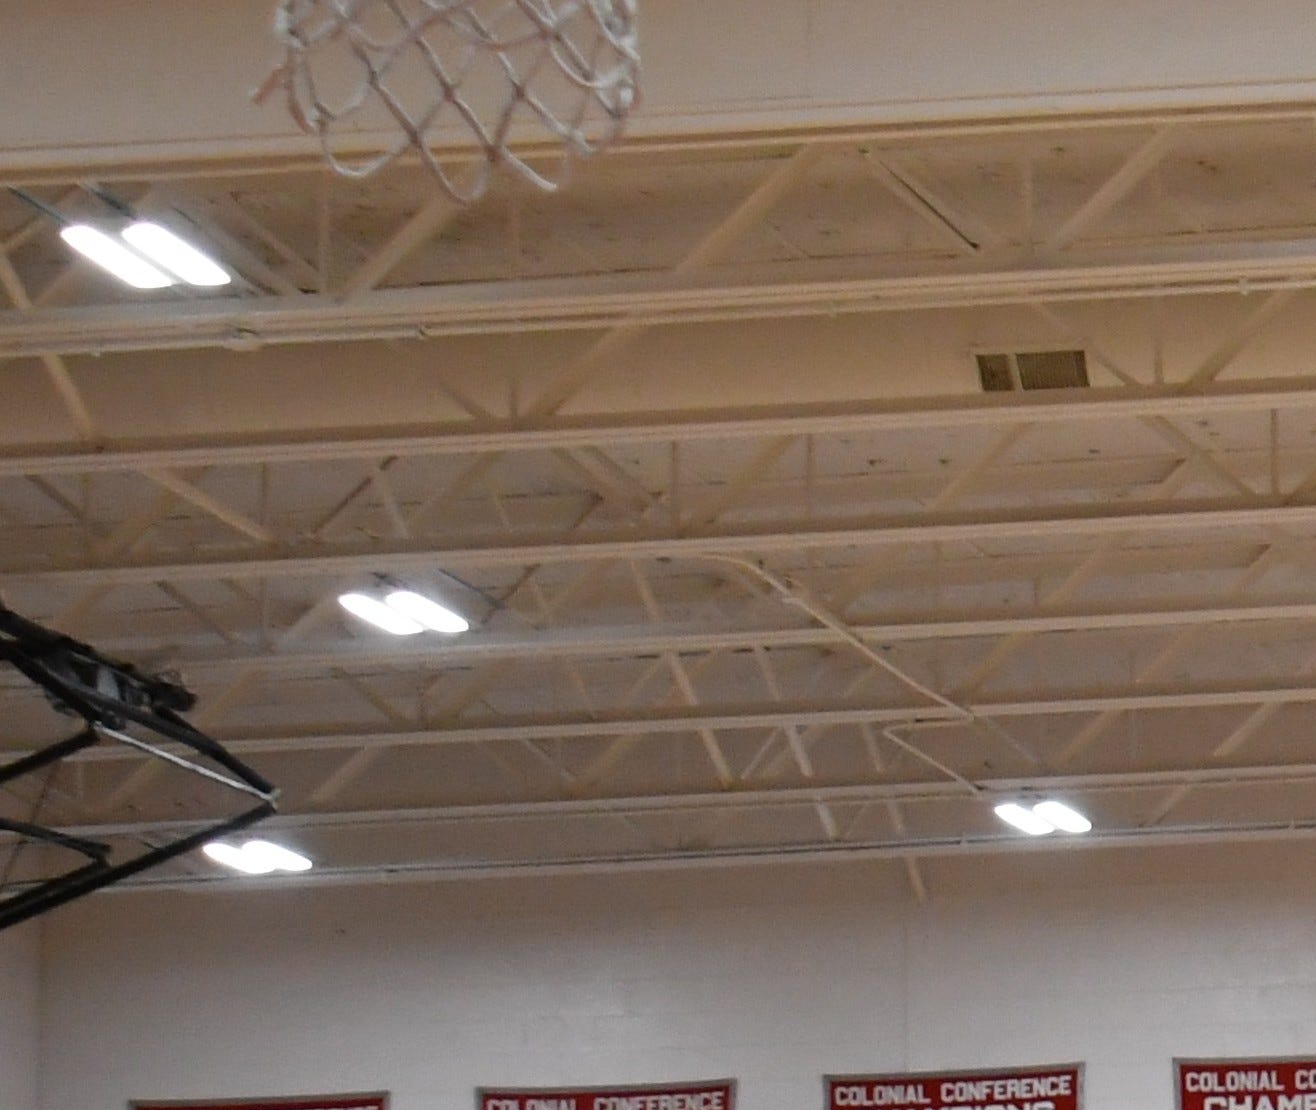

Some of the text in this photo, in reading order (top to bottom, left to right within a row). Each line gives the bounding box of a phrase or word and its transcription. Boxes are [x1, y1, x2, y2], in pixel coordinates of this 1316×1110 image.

[835, 1075, 1072, 1106] COLONIAL CONFERENCE
[1186, 1070, 1285, 1093] COLONIAL
